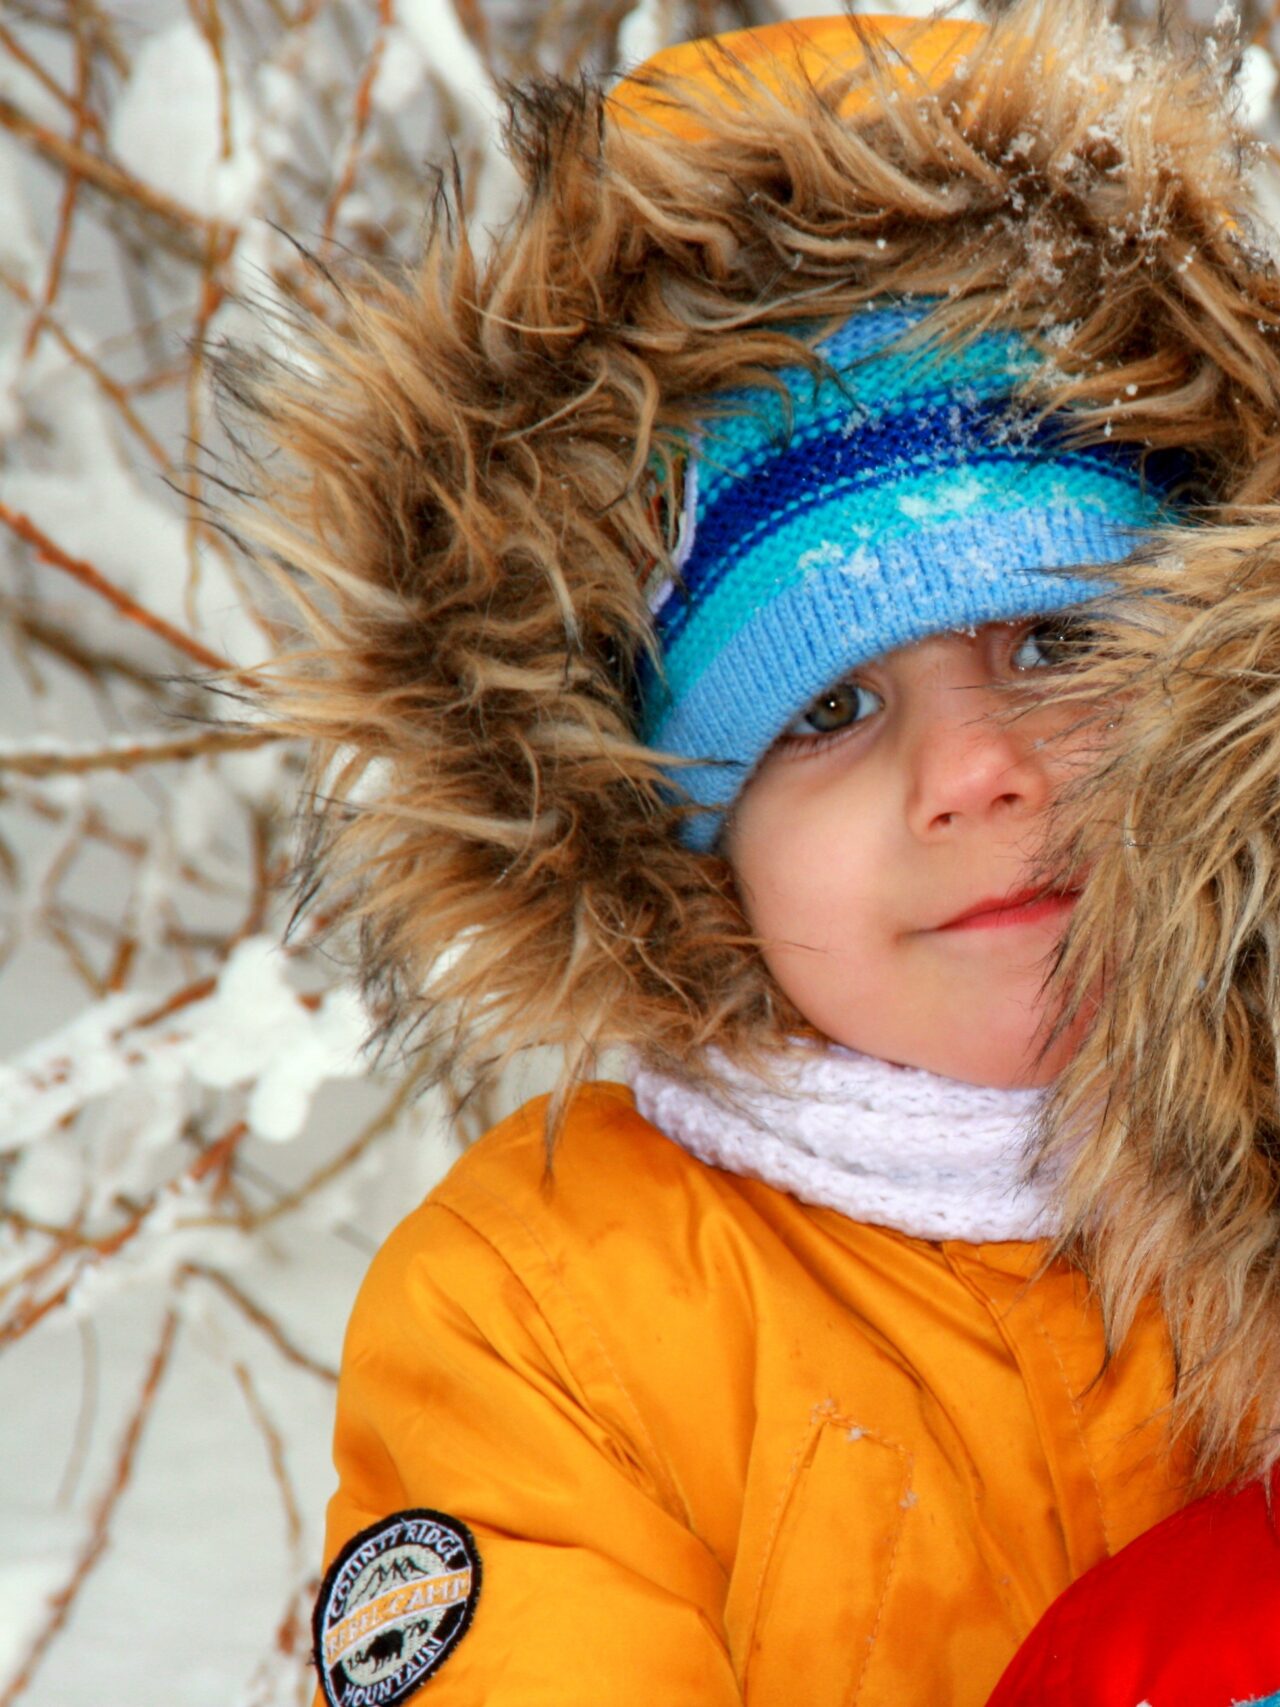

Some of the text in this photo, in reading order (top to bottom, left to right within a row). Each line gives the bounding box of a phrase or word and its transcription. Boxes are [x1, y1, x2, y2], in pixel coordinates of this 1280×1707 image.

[329, 1523, 461, 1618] COUNTY RIDGE
[387, 1577, 467, 1614] CAMP
[339, 1637, 444, 1706] MOUNTAIN
